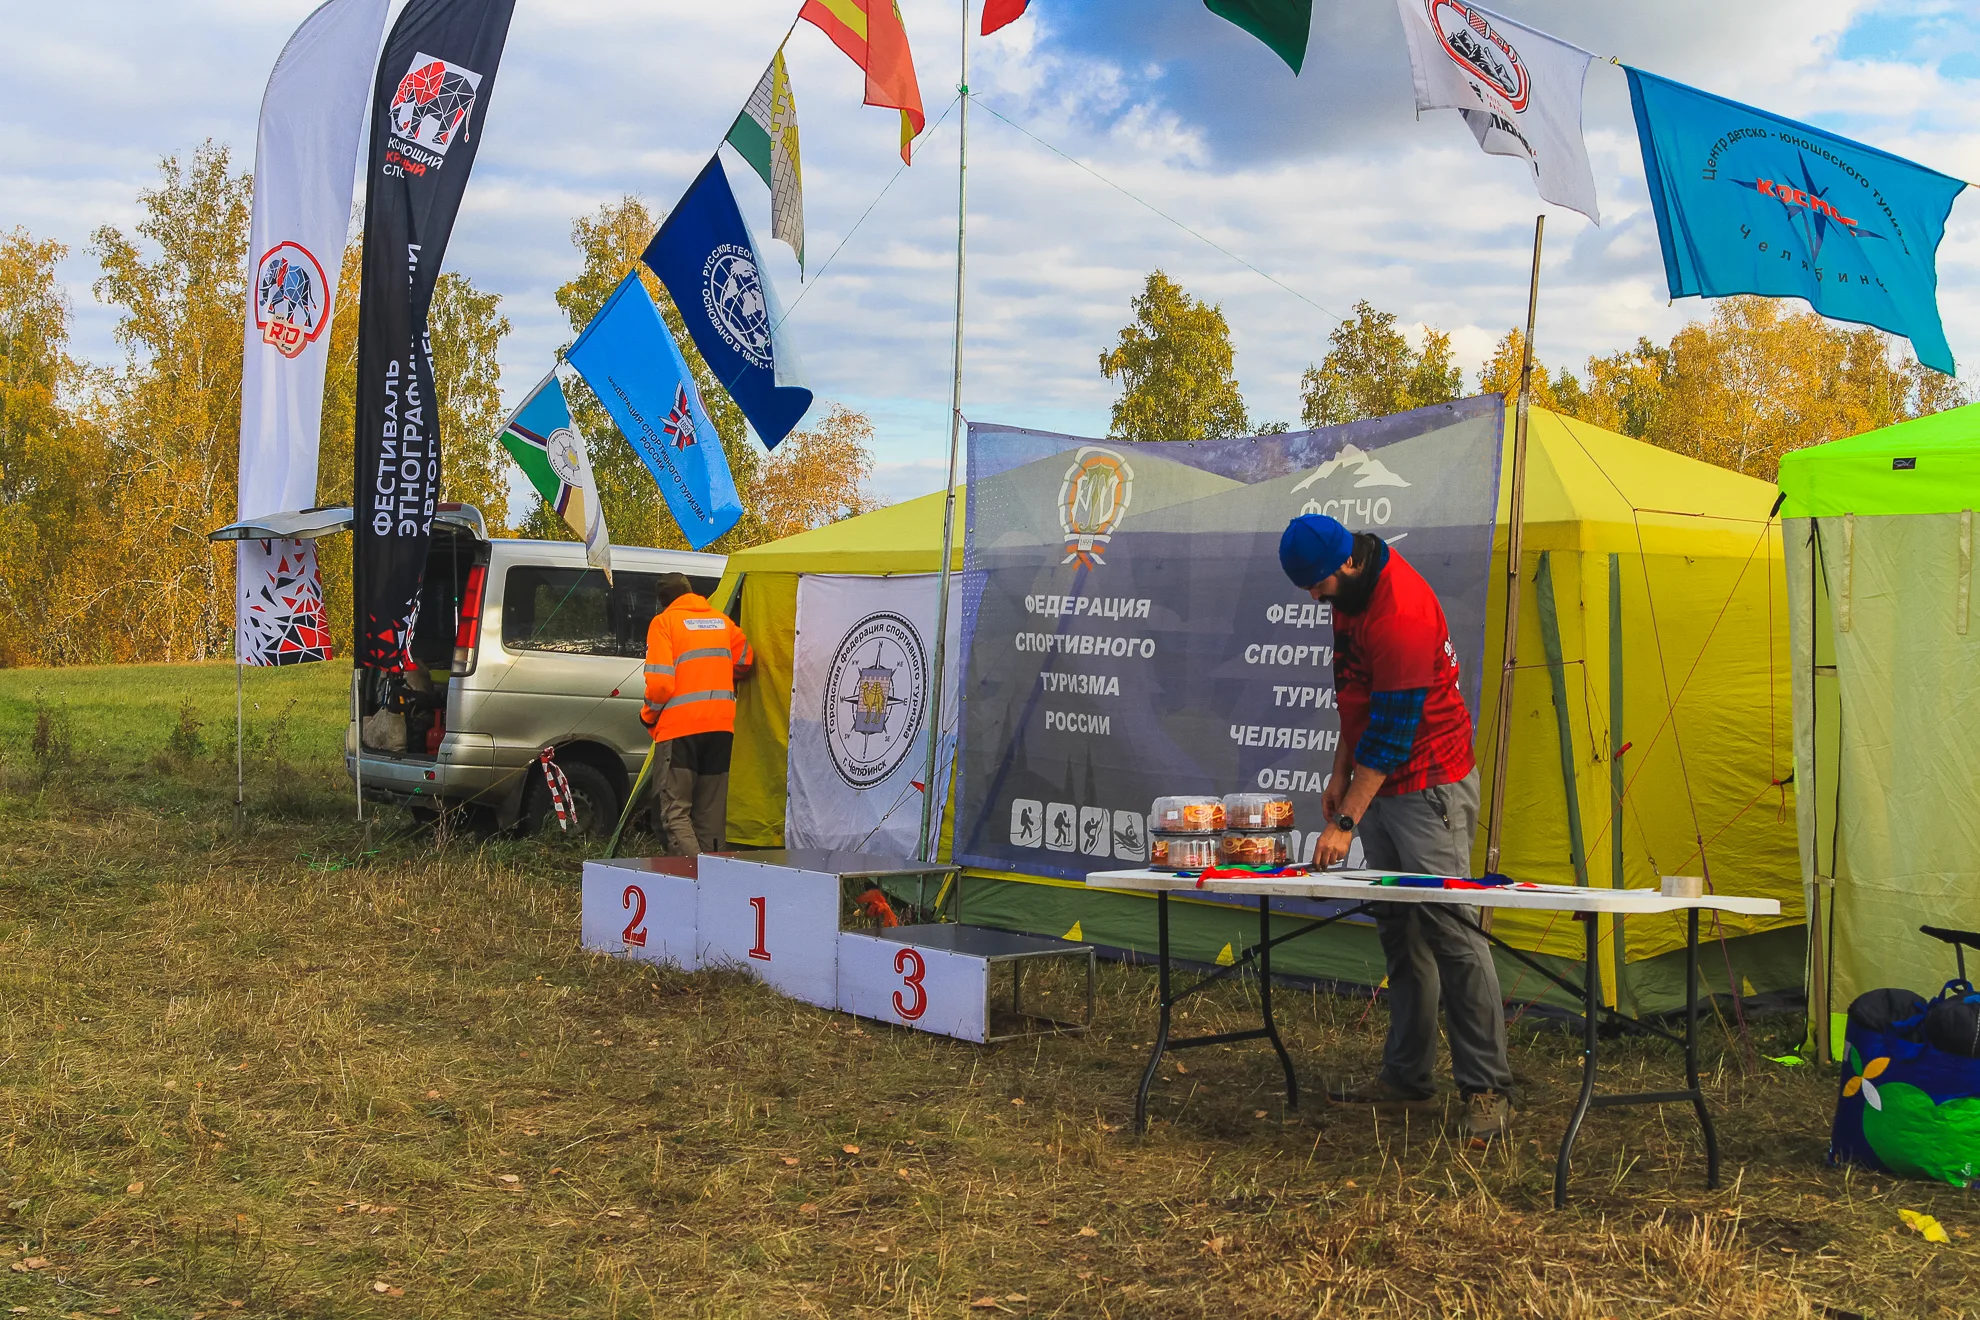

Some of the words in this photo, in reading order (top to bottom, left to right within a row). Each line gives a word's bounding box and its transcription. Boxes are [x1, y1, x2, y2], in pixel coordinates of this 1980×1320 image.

[1702, 137, 1728, 181] Центр
[1727, 128, 1767, 145] детско
[1779, 132, 1869, 189] юношеского
[702, 243, 731, 277] РУССКОЕ
[702, 288, 734, 345] ОСНОВАНО
[732, 342, 741, 353] В
[742, 349, 759, 367] 1845
[680, 419, 691, 434] 1895
[372, 359, 400, 537] ФЕСТИВАЛЬ
[639, 435, 665, 472] РОССИИ
[641, 424, 682, 484] СПОРТИВНОГО
[679, 482, 706, 522] ТУРИЗМА
[1300, 497, 1392, 525] ФСТЧО
[1025, 594, 1151, 621] ФЕДЕРАЦИЯ
[1266, 603, 1333, 629] ФЕДЕ
[1015, 632, 1156, 659] СПОРТИВНОГО
[829, 665, 842, 735] Городская
[840, 623, 885, 664] федерация
[886, 624, 920, 681] спортивного
[903, 683, 920, 740] туризма
[1040, 671, 1120, 697] ТУРИЗМА
[1045, 710, 1110, 736] РОССИИ
[848, 759, 887, 777] Челябинск
[622, 884, 649, 948] 2
[748, 896, 771, 962] 1
[892, 947, 928, 1021] 3
